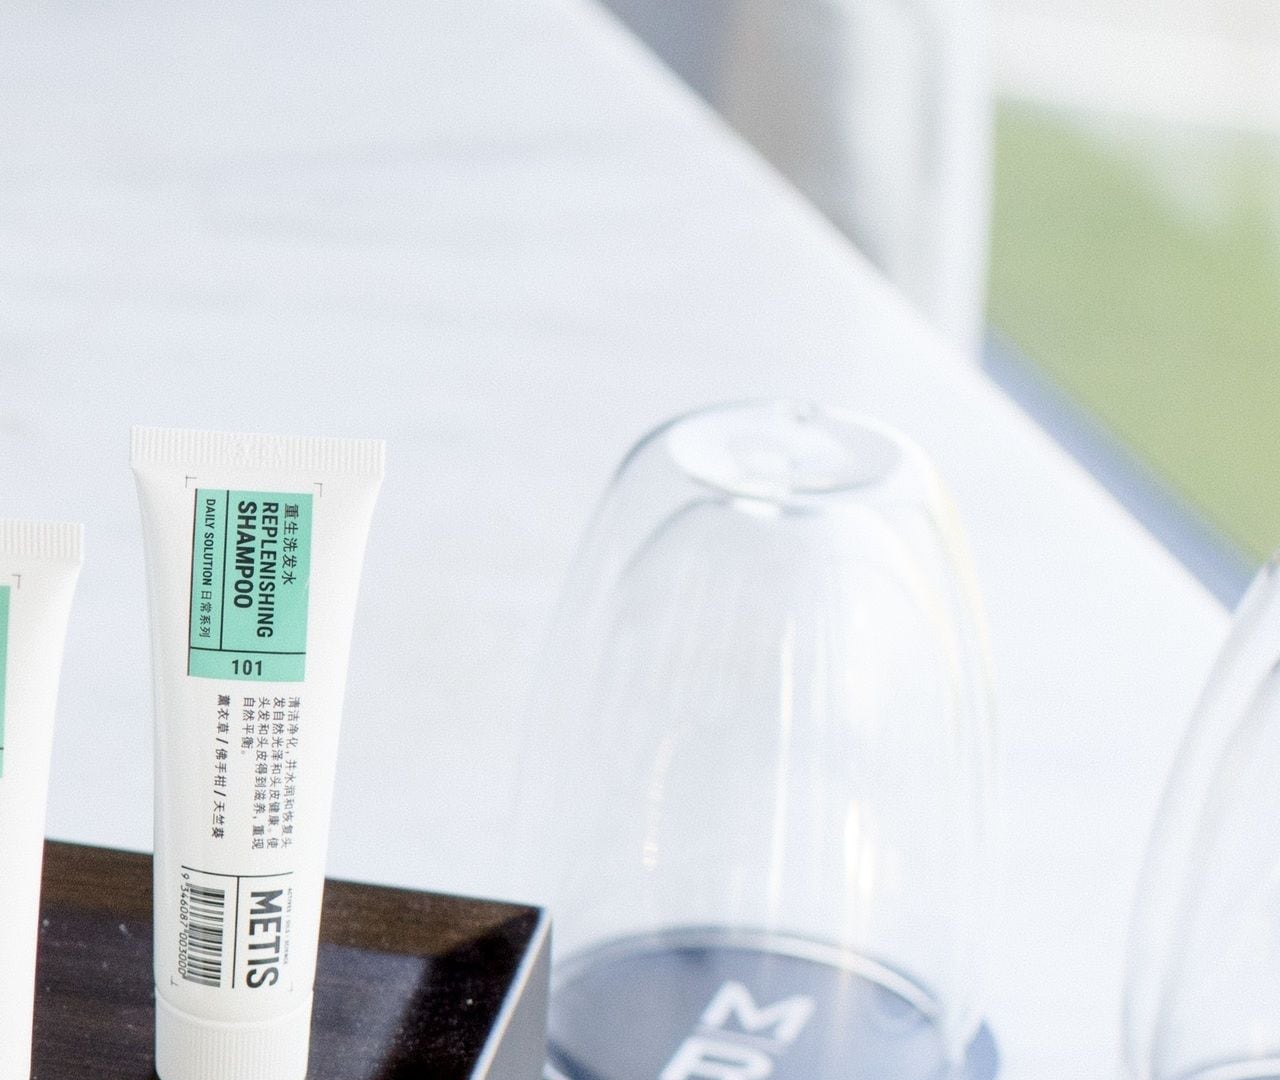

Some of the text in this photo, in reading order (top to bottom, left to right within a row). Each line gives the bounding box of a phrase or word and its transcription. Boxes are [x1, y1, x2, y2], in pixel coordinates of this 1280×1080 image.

[199, 499, 216, 638] DAILY SOLUTION 日常系列
[234, 501, 256, 608] SHAMPOO
[282, 504, 299, 585] 重生洗发水
[257, 502, 278, 638] REPLENISHING
[232, 660, 262, 676] 101
[217, 695, 230, 734] 薰衣草
[241, 697, 256, 755] 自然平衡。
[215, 749, 228, 787] 佛手柑
[212, 801, 225, 839] 天竺葵
[180, 885, 188, 927] 346087
[178, 932, 187, 975] 003000
[246, 889, 283, 988] METIS
